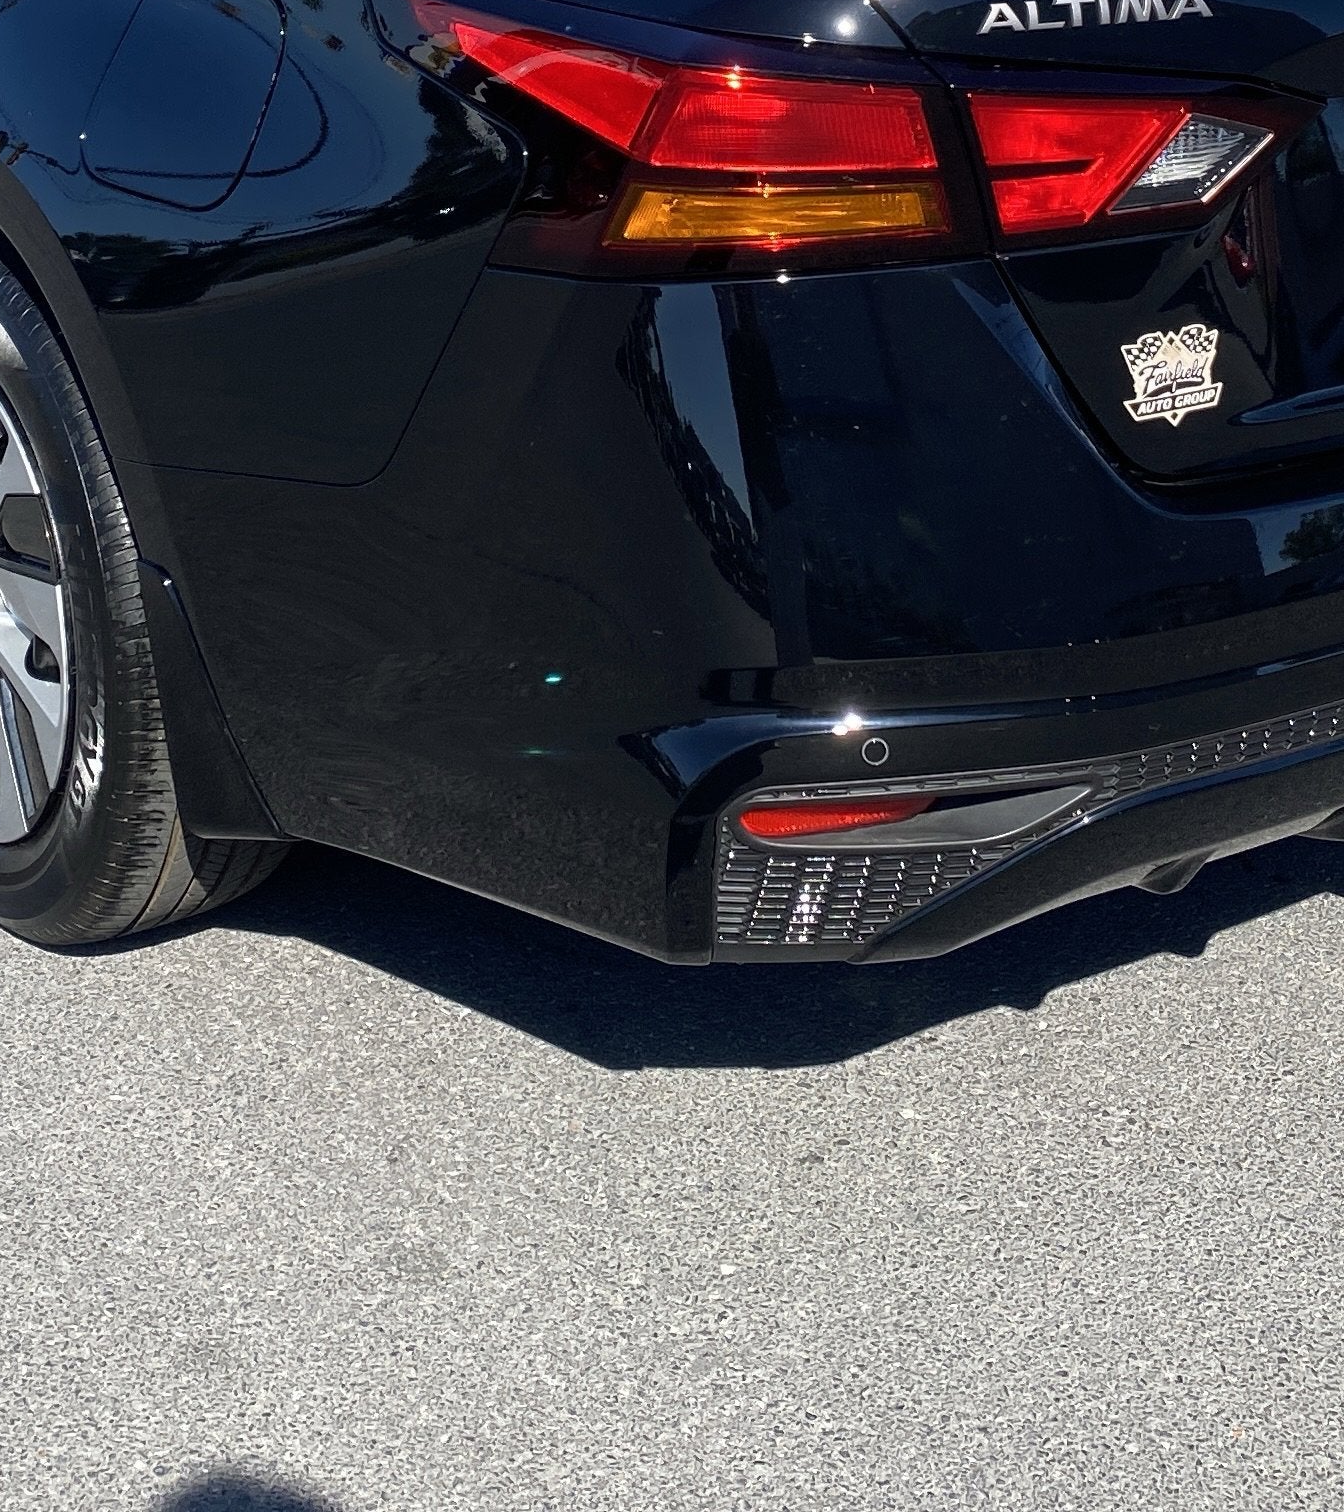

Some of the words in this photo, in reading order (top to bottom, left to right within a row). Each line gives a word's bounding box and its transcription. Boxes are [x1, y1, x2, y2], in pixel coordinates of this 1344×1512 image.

[1139, 356, 1208, 396] Fairfield
[1137, 397, 1173, 416] AUTO
[1174, 388, 1216, 408] GROUP
